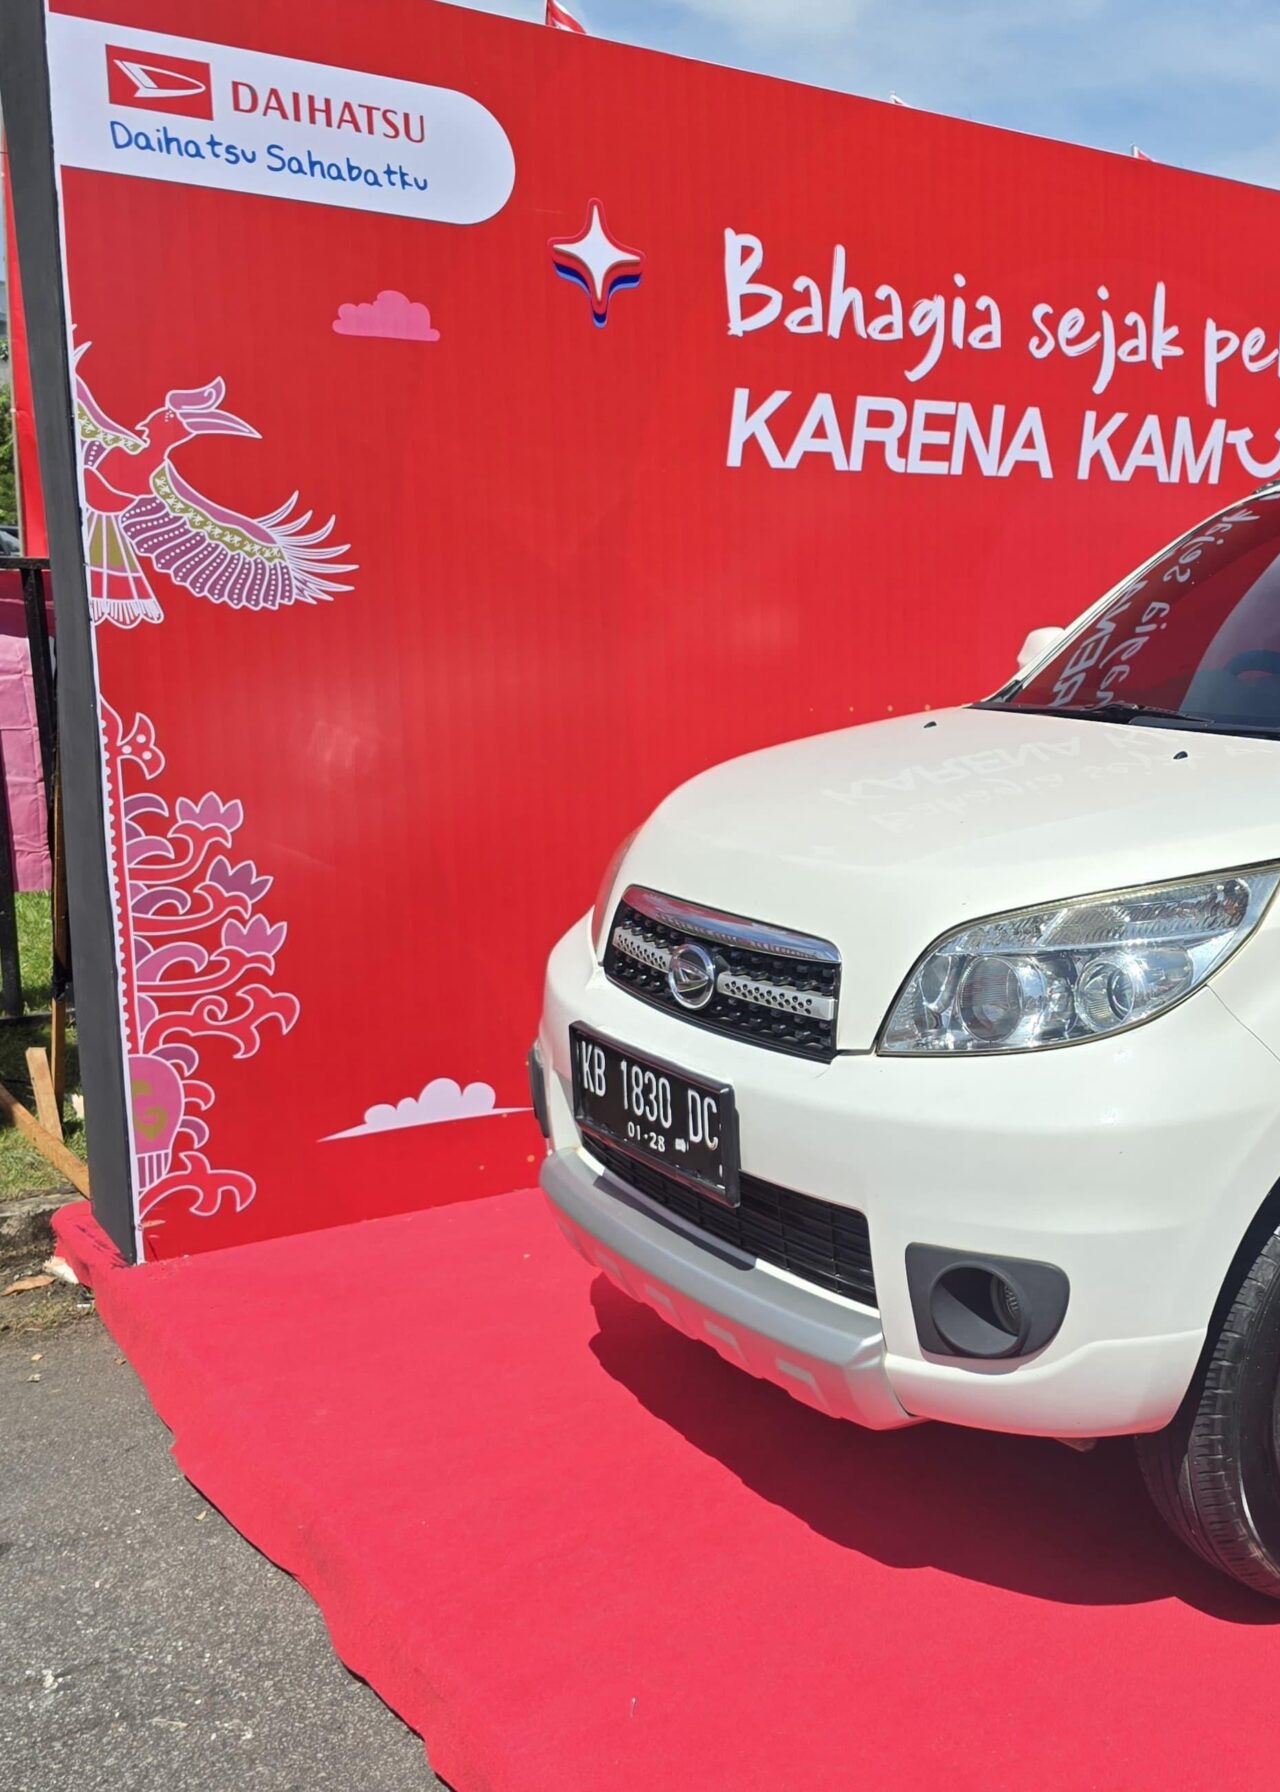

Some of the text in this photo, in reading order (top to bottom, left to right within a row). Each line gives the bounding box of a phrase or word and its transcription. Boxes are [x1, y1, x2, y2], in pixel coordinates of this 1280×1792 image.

[109, 120, 428, 191] Daihatsu Sahabatku
[231, 80, 425, 143] DAIHATSU
[724, 227, 1001, 382] Bahagia
[1028, 281, 1184, 395] sejak
[726, 387, 1054, 479] KARENA
[581, 1040, 719, 1151] KB 1830 DC
